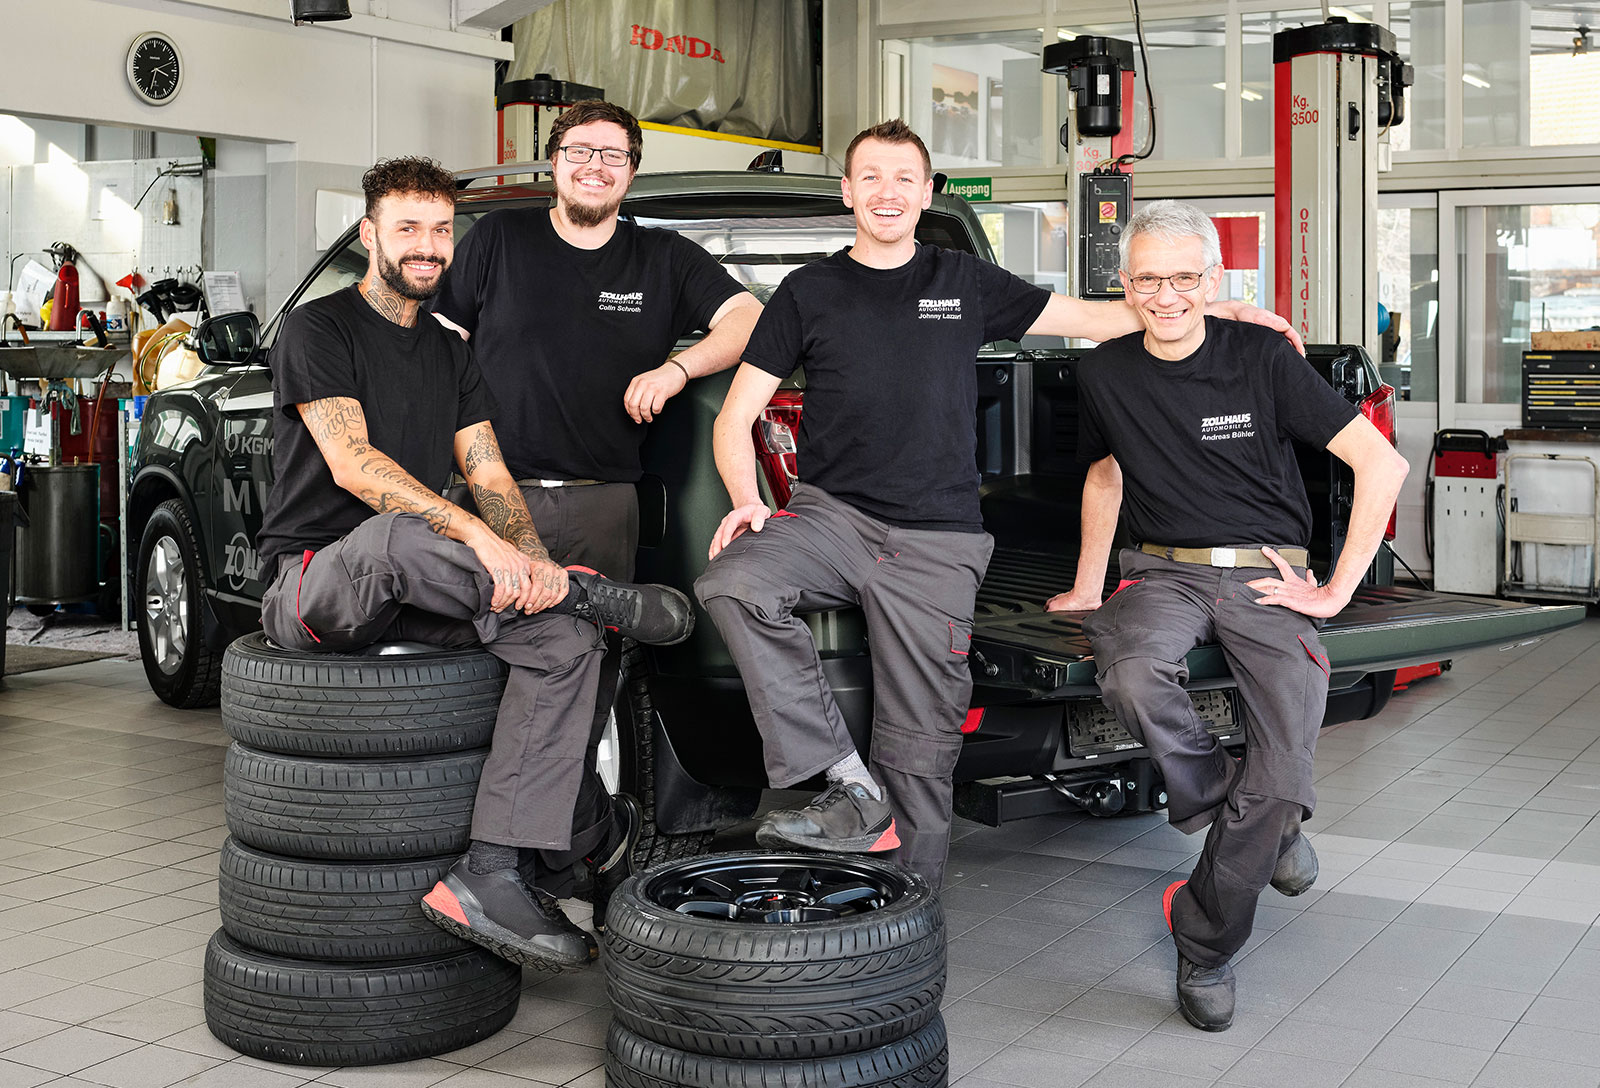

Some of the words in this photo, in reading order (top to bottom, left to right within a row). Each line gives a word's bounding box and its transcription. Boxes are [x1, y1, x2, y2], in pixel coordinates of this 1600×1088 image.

[629, 24, 726, 64] HONDA
[1293, 94, 1309, 110] Kg.
[1291, 110, 1319, 126] 3500
[1083, 147, 1101, 160] Kg.
[948, 182, 990, 197] Ausgang
[599, 291, 643, 300] ZOLLHAUS
[617, 305, 642, 313] Schroth
[918, 299, 960, 307] ZOLLHAUS
[918, 313, 941, 321] Johnny
[1201, 413, 1251, 427] ZOLLHAUS
[1201, 424, 1240, 432] AUTOMOBILE
[1201, 433, 1231, 441] Andreas
[1231, 430, 1255, 439] Bühler
[241, 436, 275, 456] KGM
